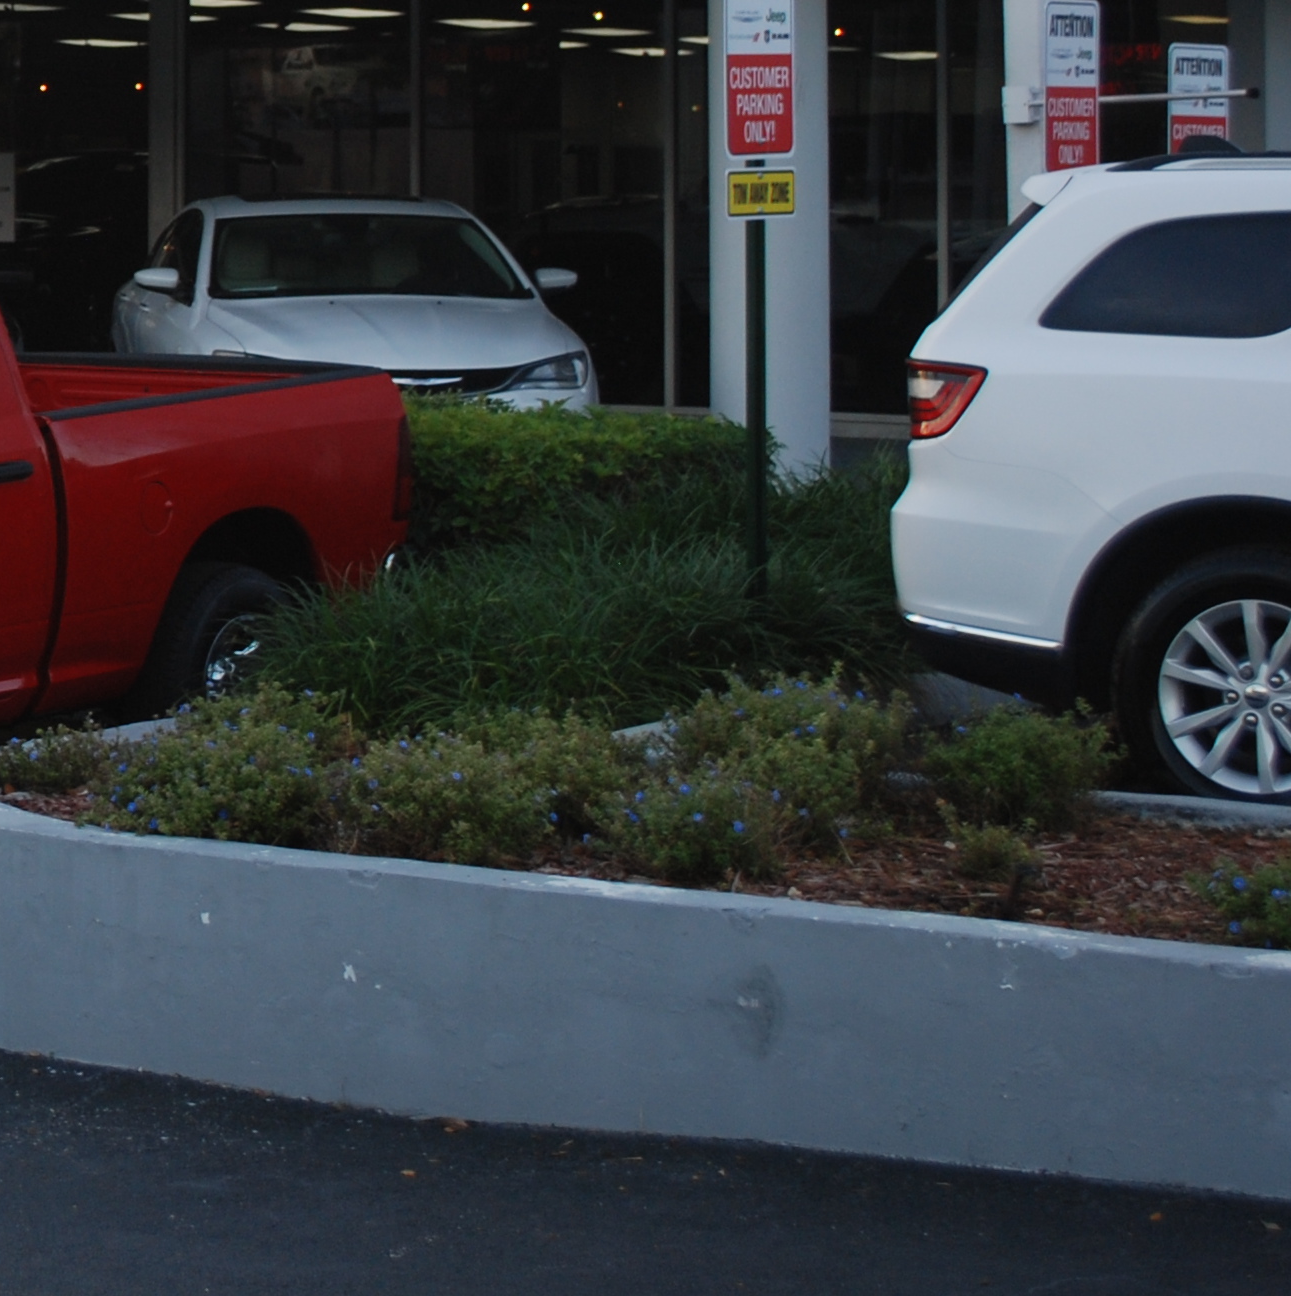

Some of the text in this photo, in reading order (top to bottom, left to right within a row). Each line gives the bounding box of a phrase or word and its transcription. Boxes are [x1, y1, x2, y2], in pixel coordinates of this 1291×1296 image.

[766, 7, 787, 25] Jeep
[1049, 14, 1094, 39] ATTENTION
[1174, 56, 1222, 77] ATTENTION
[729, 66, 790, 89] CUSTOMER
[736, 93, 784, 116] PARKING
[1048, 97, 1095, 117] CUSTOMER
[744, 120, 776, 142] ONLY!
[1052, 121, 1090, 141] PARKING
[1058, 145, 1084, 165] ONLY!
[733, 181, 790, 204] TOW AWAY ZONE
